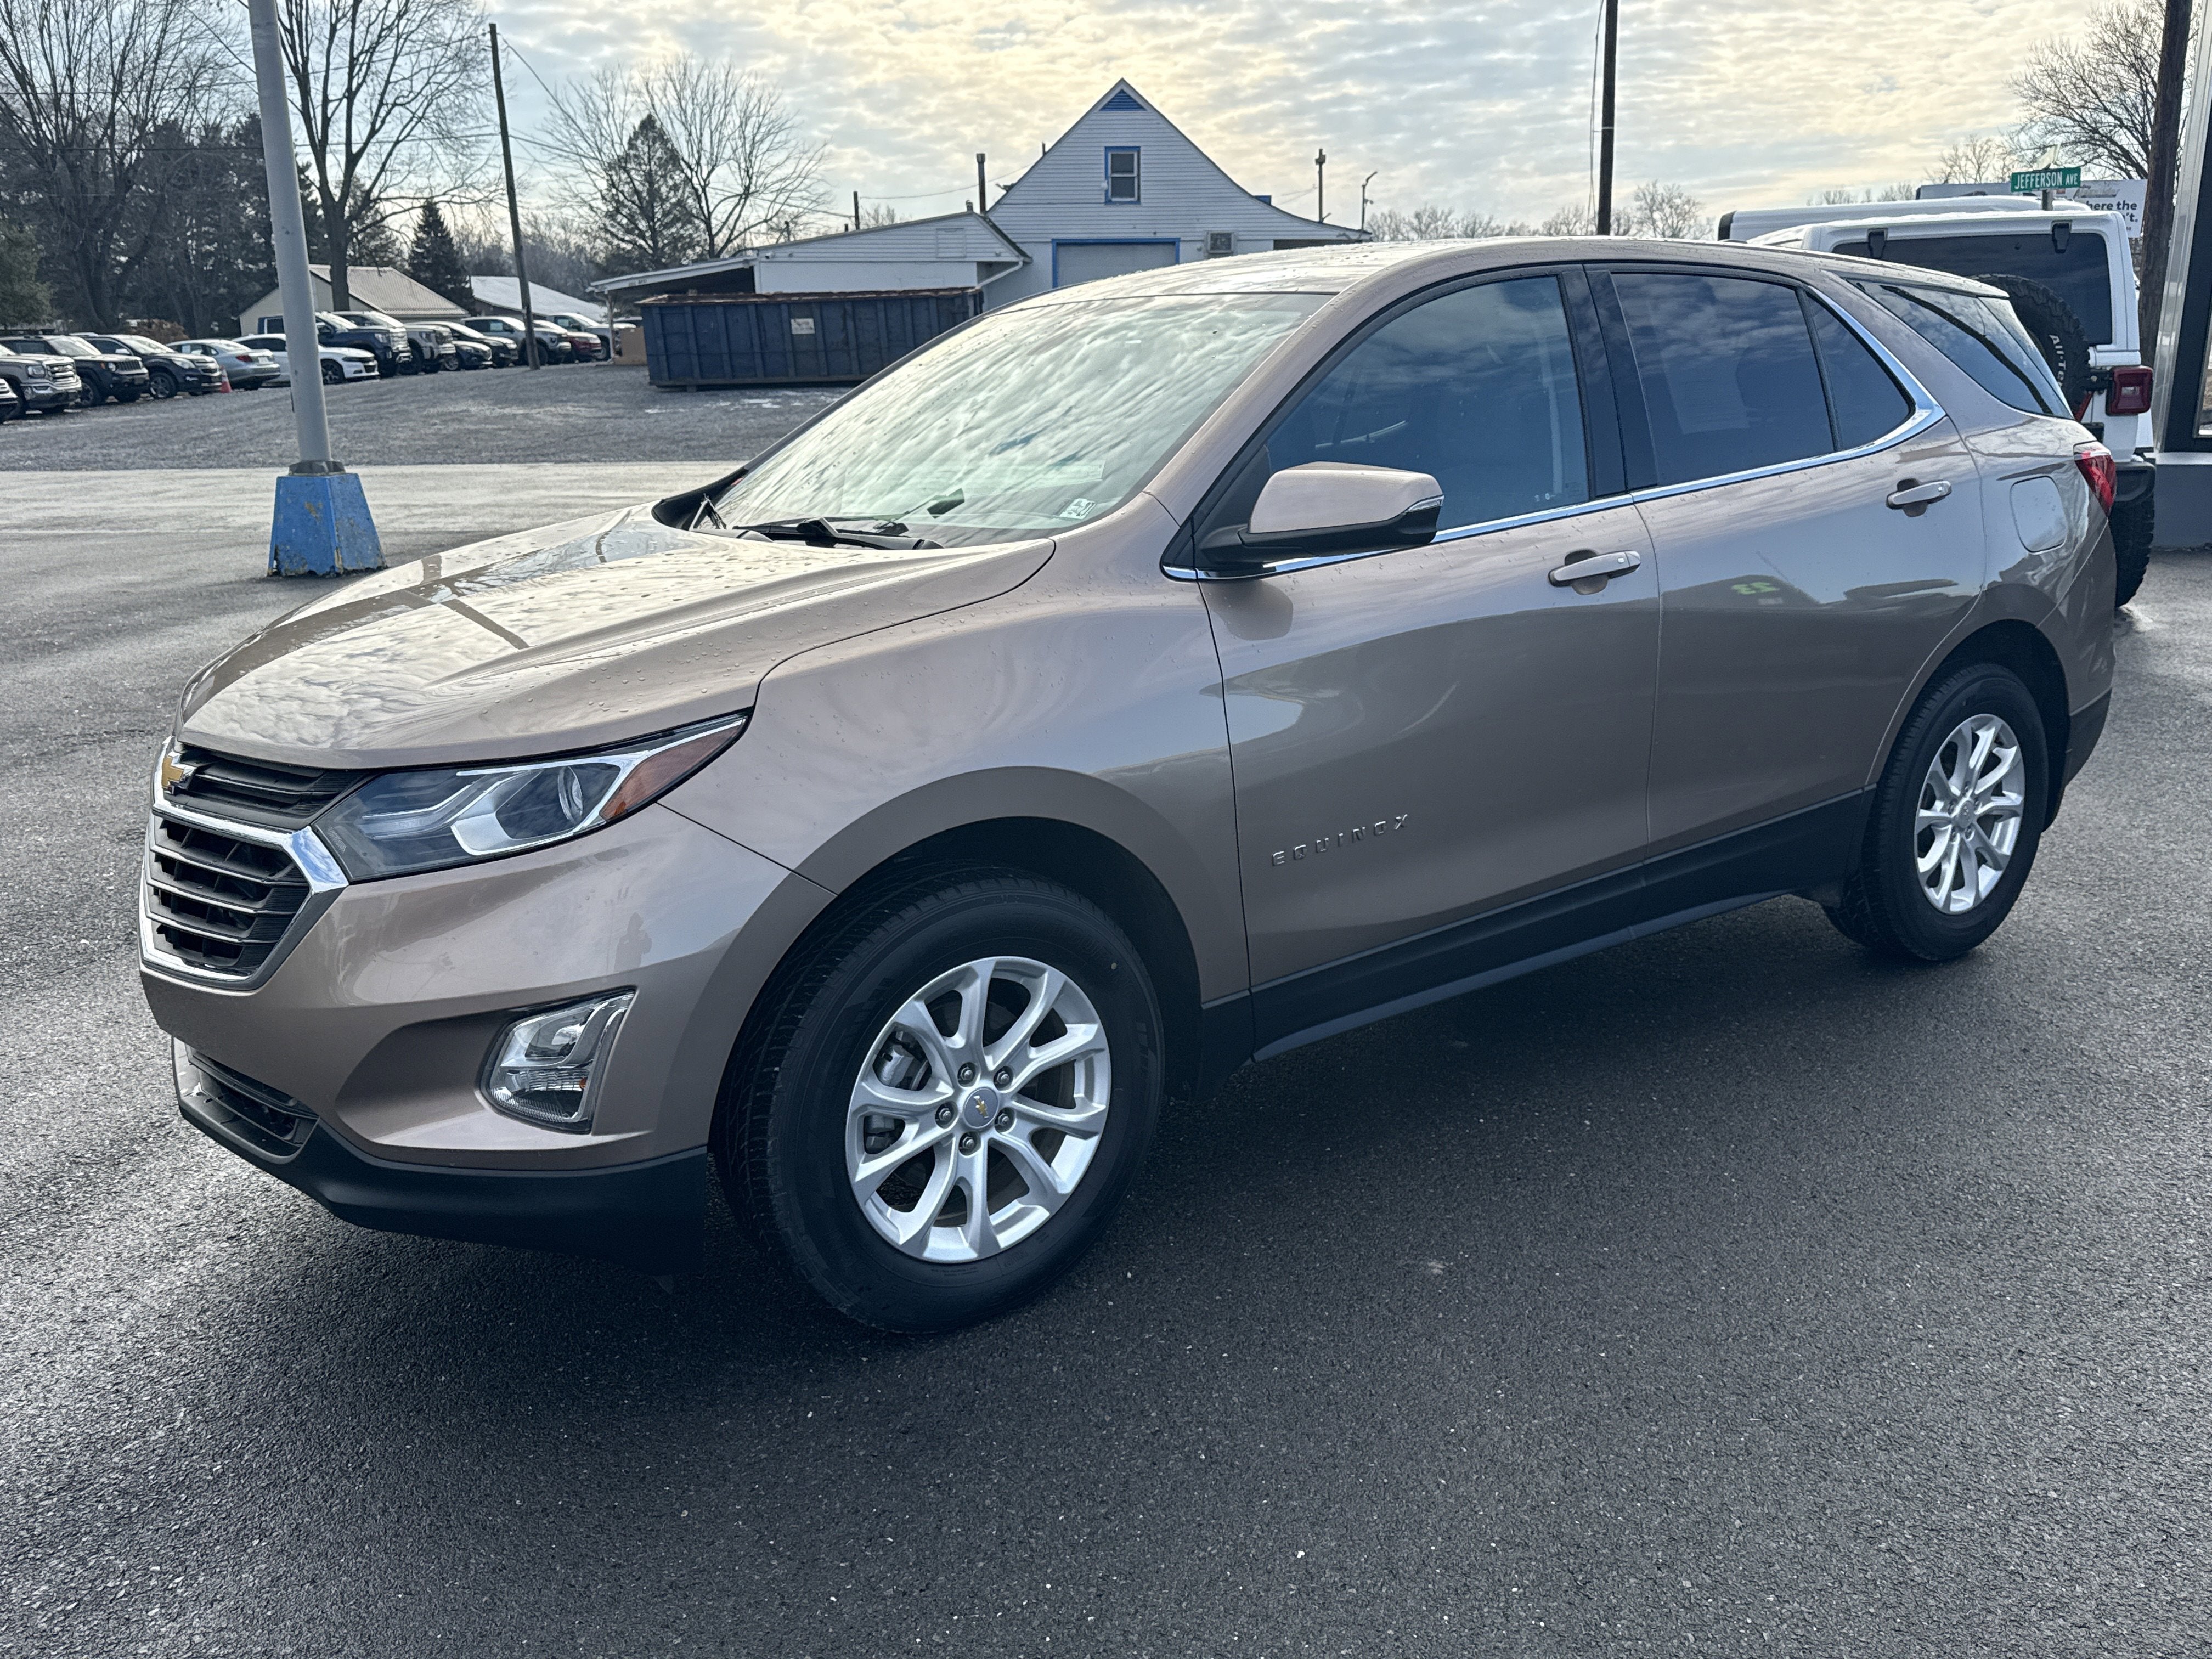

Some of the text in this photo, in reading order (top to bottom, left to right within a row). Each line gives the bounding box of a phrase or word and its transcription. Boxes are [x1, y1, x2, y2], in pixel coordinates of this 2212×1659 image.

[2015, 171, 2078, 189] JEFFERSON AVE
[2086, 200, 2137, 210] here the
[1272, 814, 1408, 866] EQUINOX
